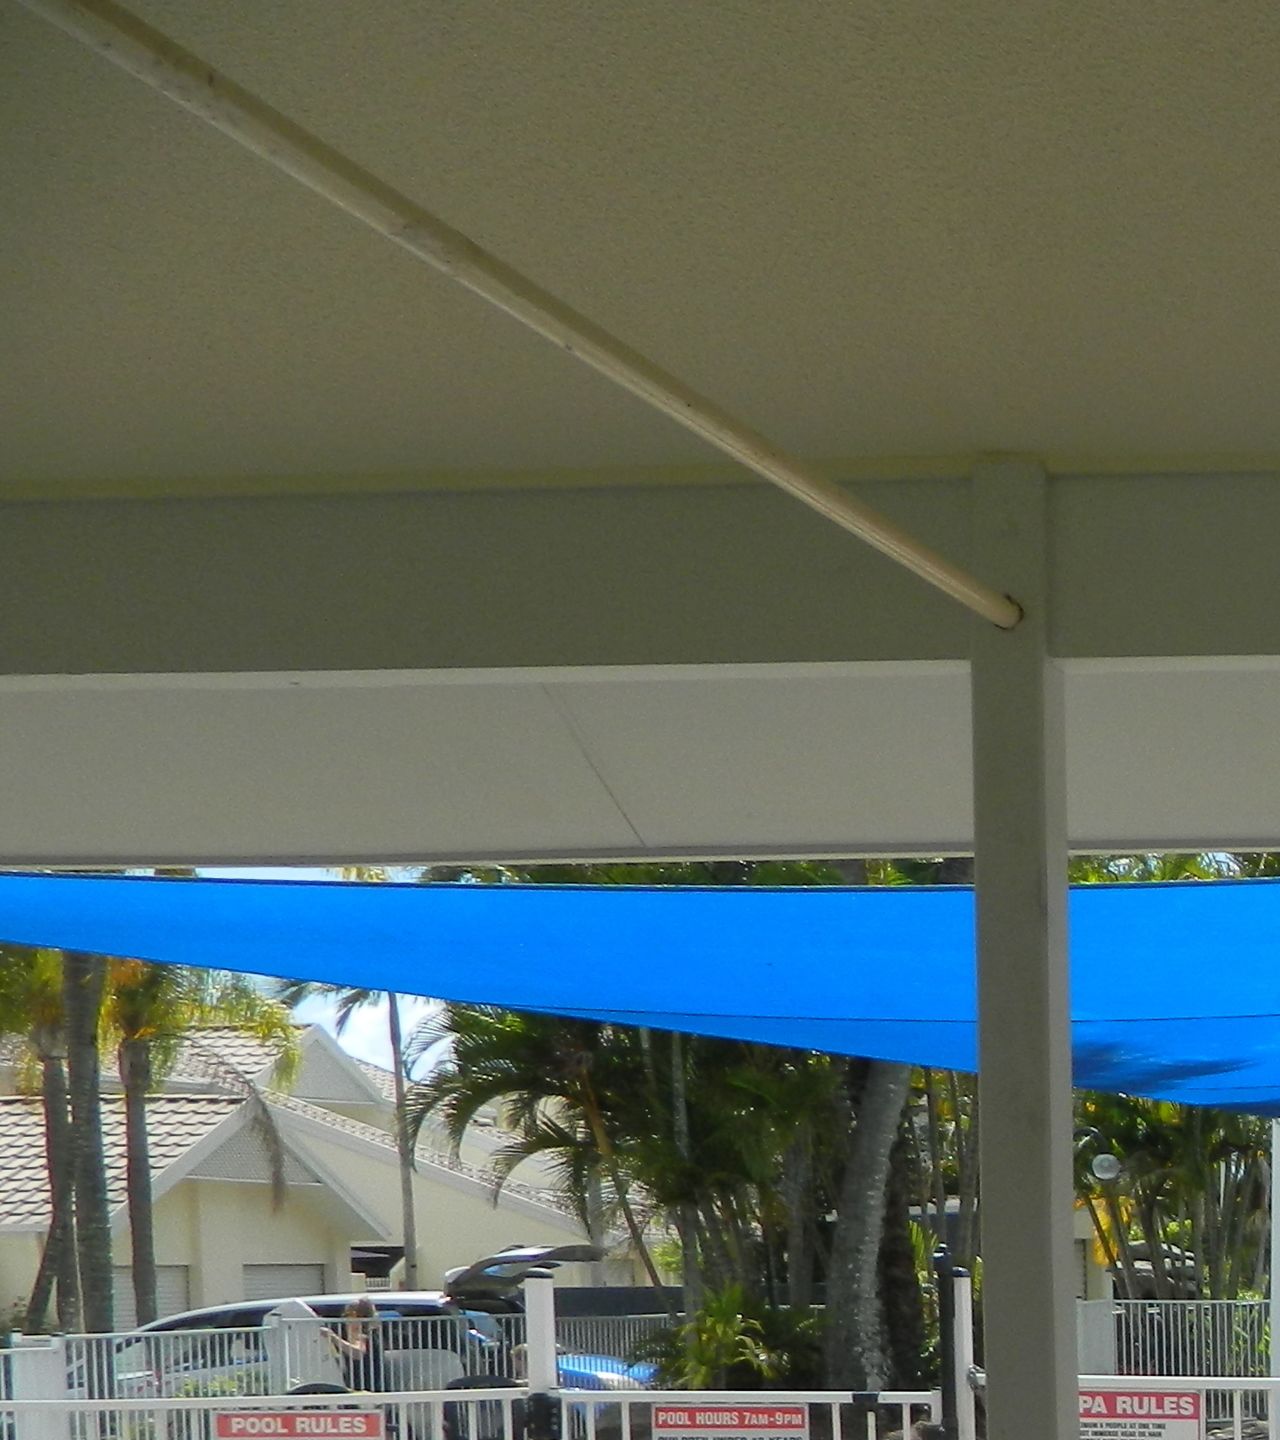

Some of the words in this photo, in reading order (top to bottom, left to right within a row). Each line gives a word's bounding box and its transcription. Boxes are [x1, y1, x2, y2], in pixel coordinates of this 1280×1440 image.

[1079, 1396, 1107, 1414] PA
[1116, 1396, 1194, 1415] RULES
[231, 1417, 288, 1433] POOL
[296, 1417, 367, 1433] RULES
[658, 1412, 691, 1425] POOL
[696, 1412, 739, 1425] HOURS
